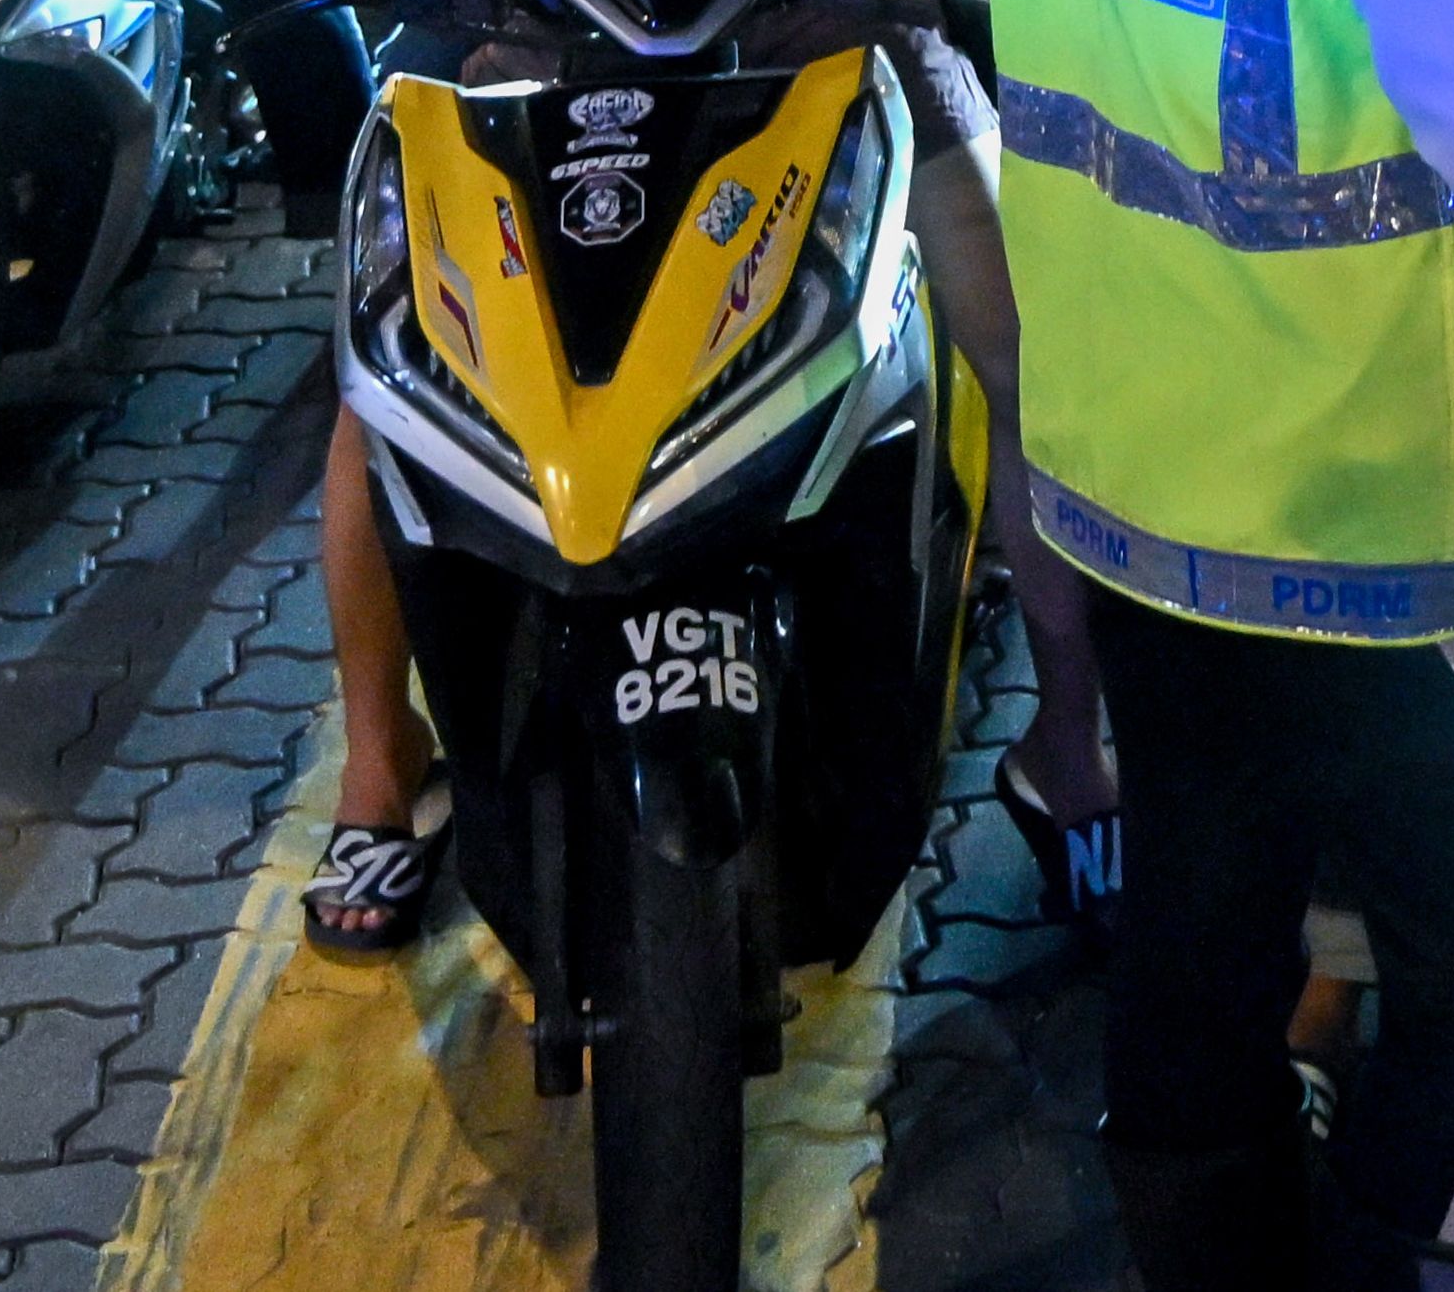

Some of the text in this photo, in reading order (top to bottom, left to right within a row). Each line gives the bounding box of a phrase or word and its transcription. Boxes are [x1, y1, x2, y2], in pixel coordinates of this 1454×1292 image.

[731, 161, 800, 312] VARIO
[1056, 498, 1129, 570] PDRM
[1272, 573, 1412, 619] PDRM
[622, 606, 746, 665] VGT
[615, 655, 760, 725] 8216
